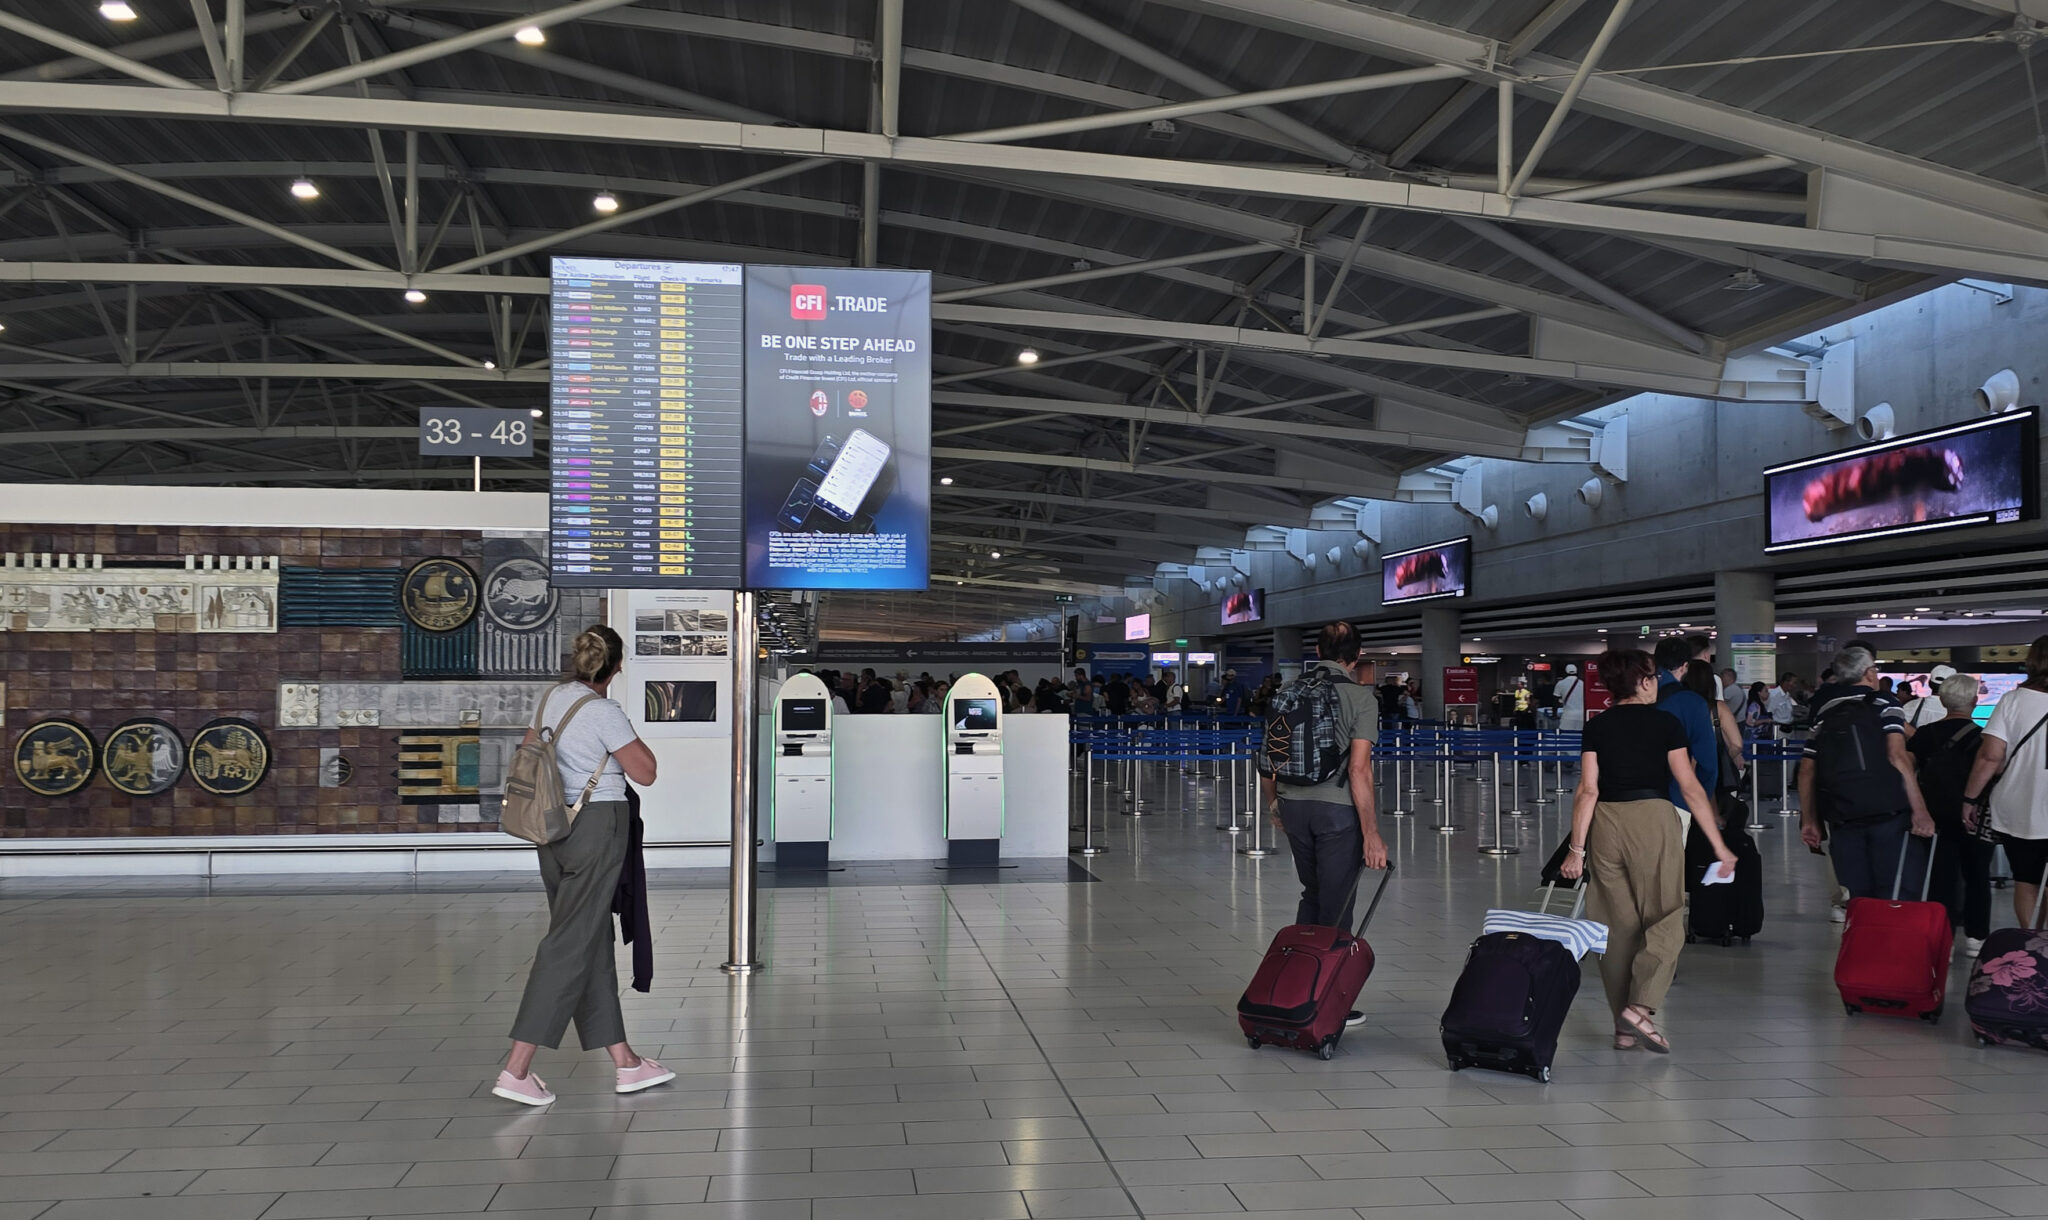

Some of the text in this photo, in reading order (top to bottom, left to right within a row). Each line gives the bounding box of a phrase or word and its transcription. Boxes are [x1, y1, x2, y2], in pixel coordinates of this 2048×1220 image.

[615, 262, 661, 272] Departures
[796, 295, 822, 310] CFI
[761, 335, 915, 352] BE ONE STEP AHEAD
[784, 353, 807, 361] Trade
[809, 354, 826, 362] with
[834, 355, 864, 364] Leading
[866, 356, 893, 364] Broker
[426, 419, 461, 444] 33
[490, 420, 526, 445] 48
